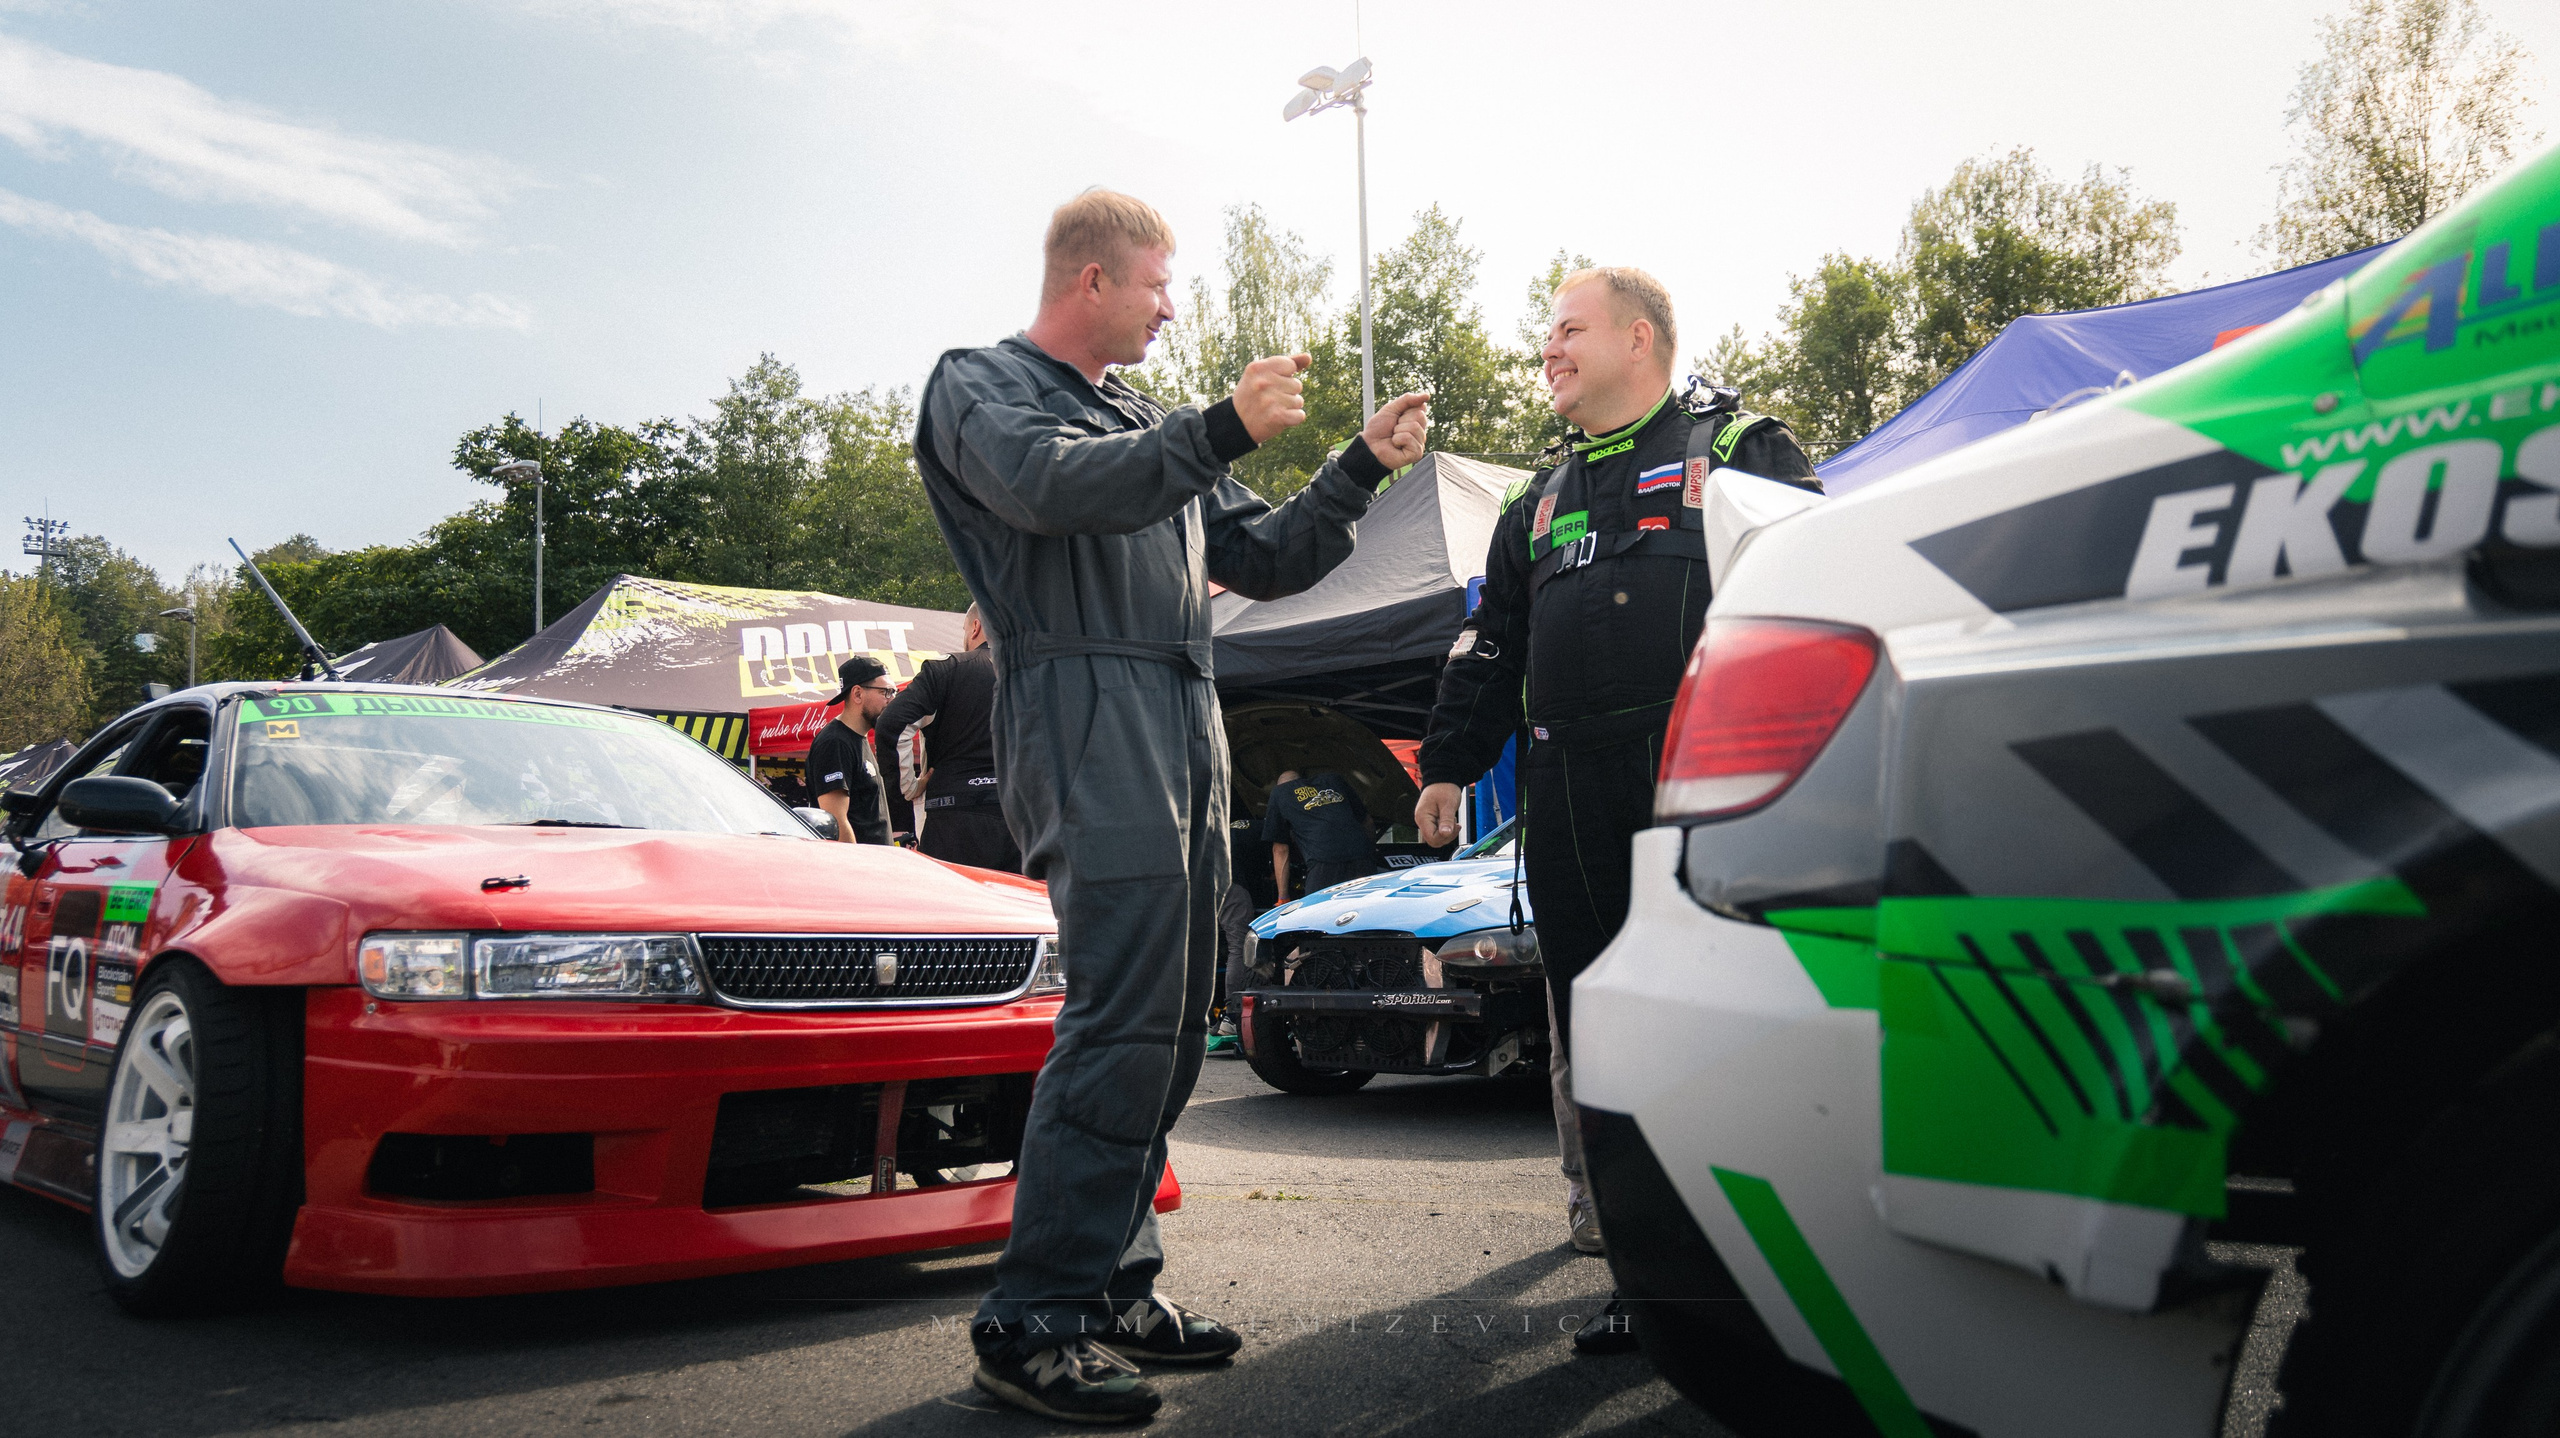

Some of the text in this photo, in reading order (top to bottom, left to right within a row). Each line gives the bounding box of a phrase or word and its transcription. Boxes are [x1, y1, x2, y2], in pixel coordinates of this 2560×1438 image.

[1637, 481, 1681, 494] ВЛАДИВОСТОК
[1690, 461, 1703, 504] SIMPSON
[1536, 499, 1551, 533] SIMPSON
[1551, 520, 1585, 539] ERA
[269, 696, 318, 714] 90
[758, 704, 829, 747] pulse of life
[105, 924, 137, 952] ATOM
[47, 935, 86, 1021] FQ
